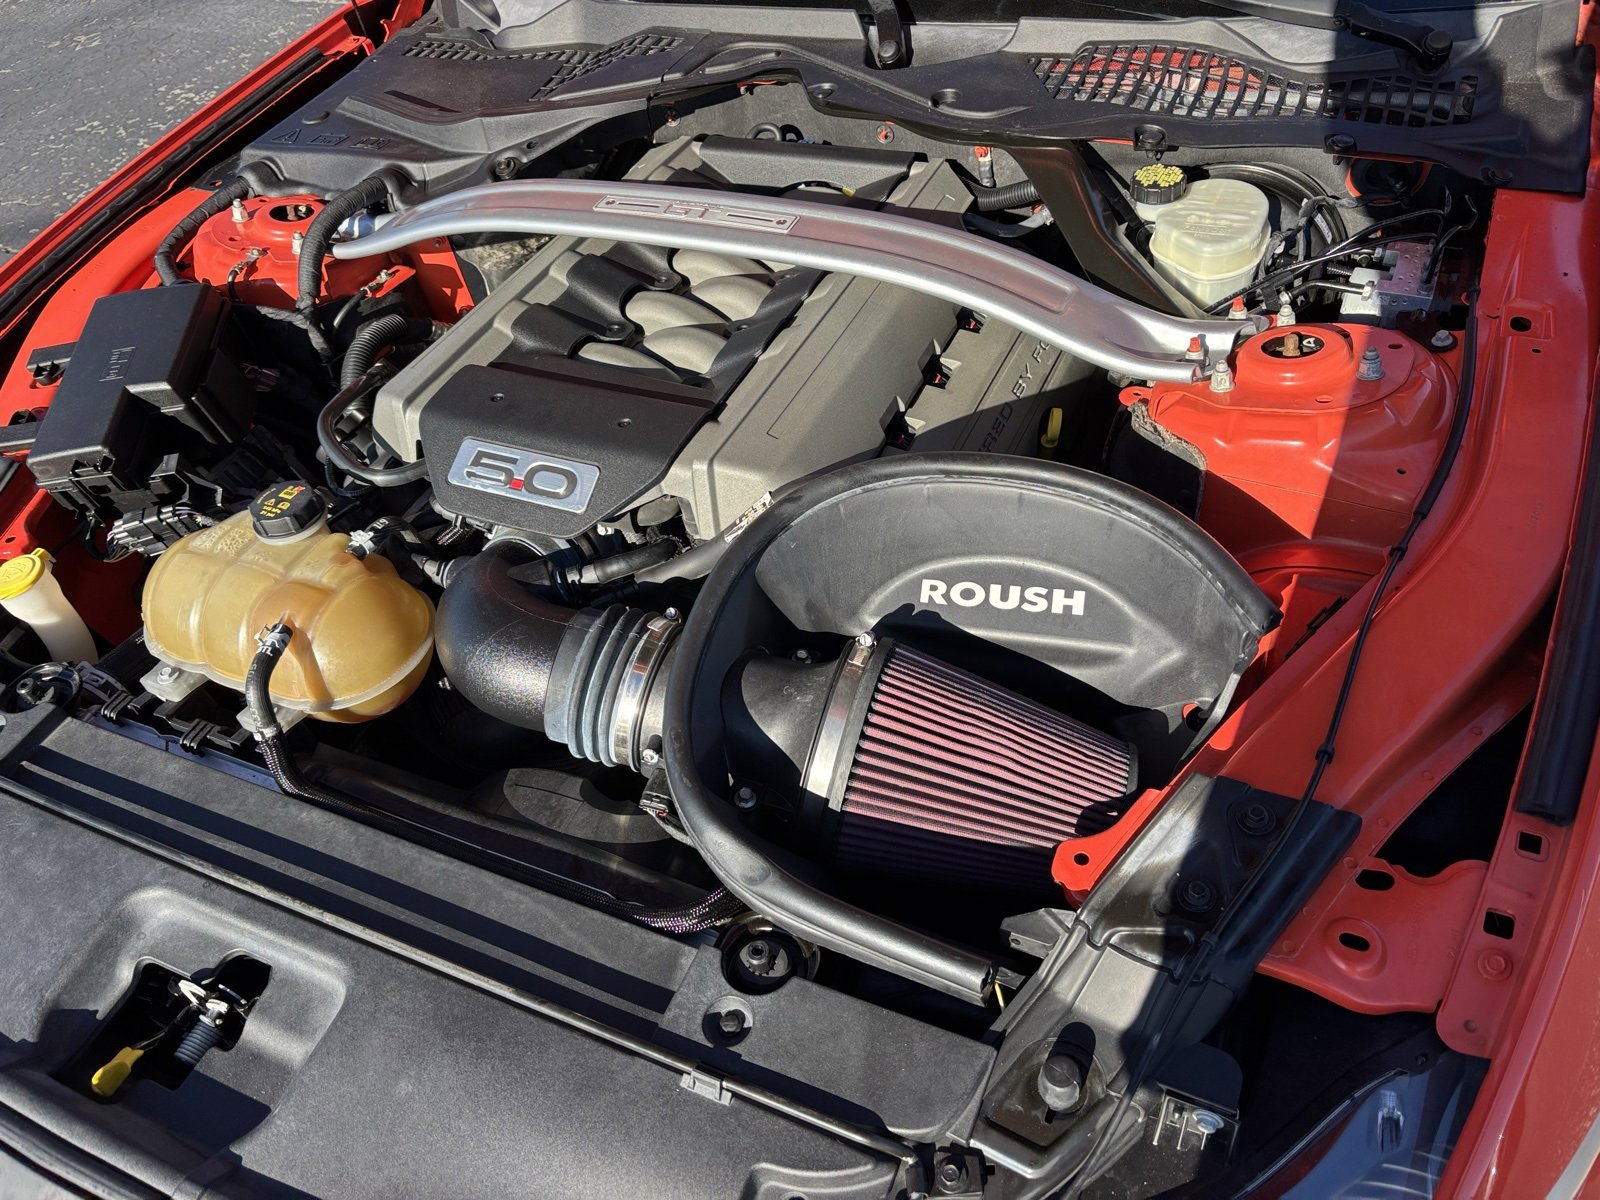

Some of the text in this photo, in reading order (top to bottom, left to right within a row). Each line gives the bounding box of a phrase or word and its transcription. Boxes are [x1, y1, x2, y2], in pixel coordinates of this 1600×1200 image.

[1011, 362, 1033, 399] BY
[463, 447, 579, 500] 5.0
[919, 578, 1086, 616] ROUSH
